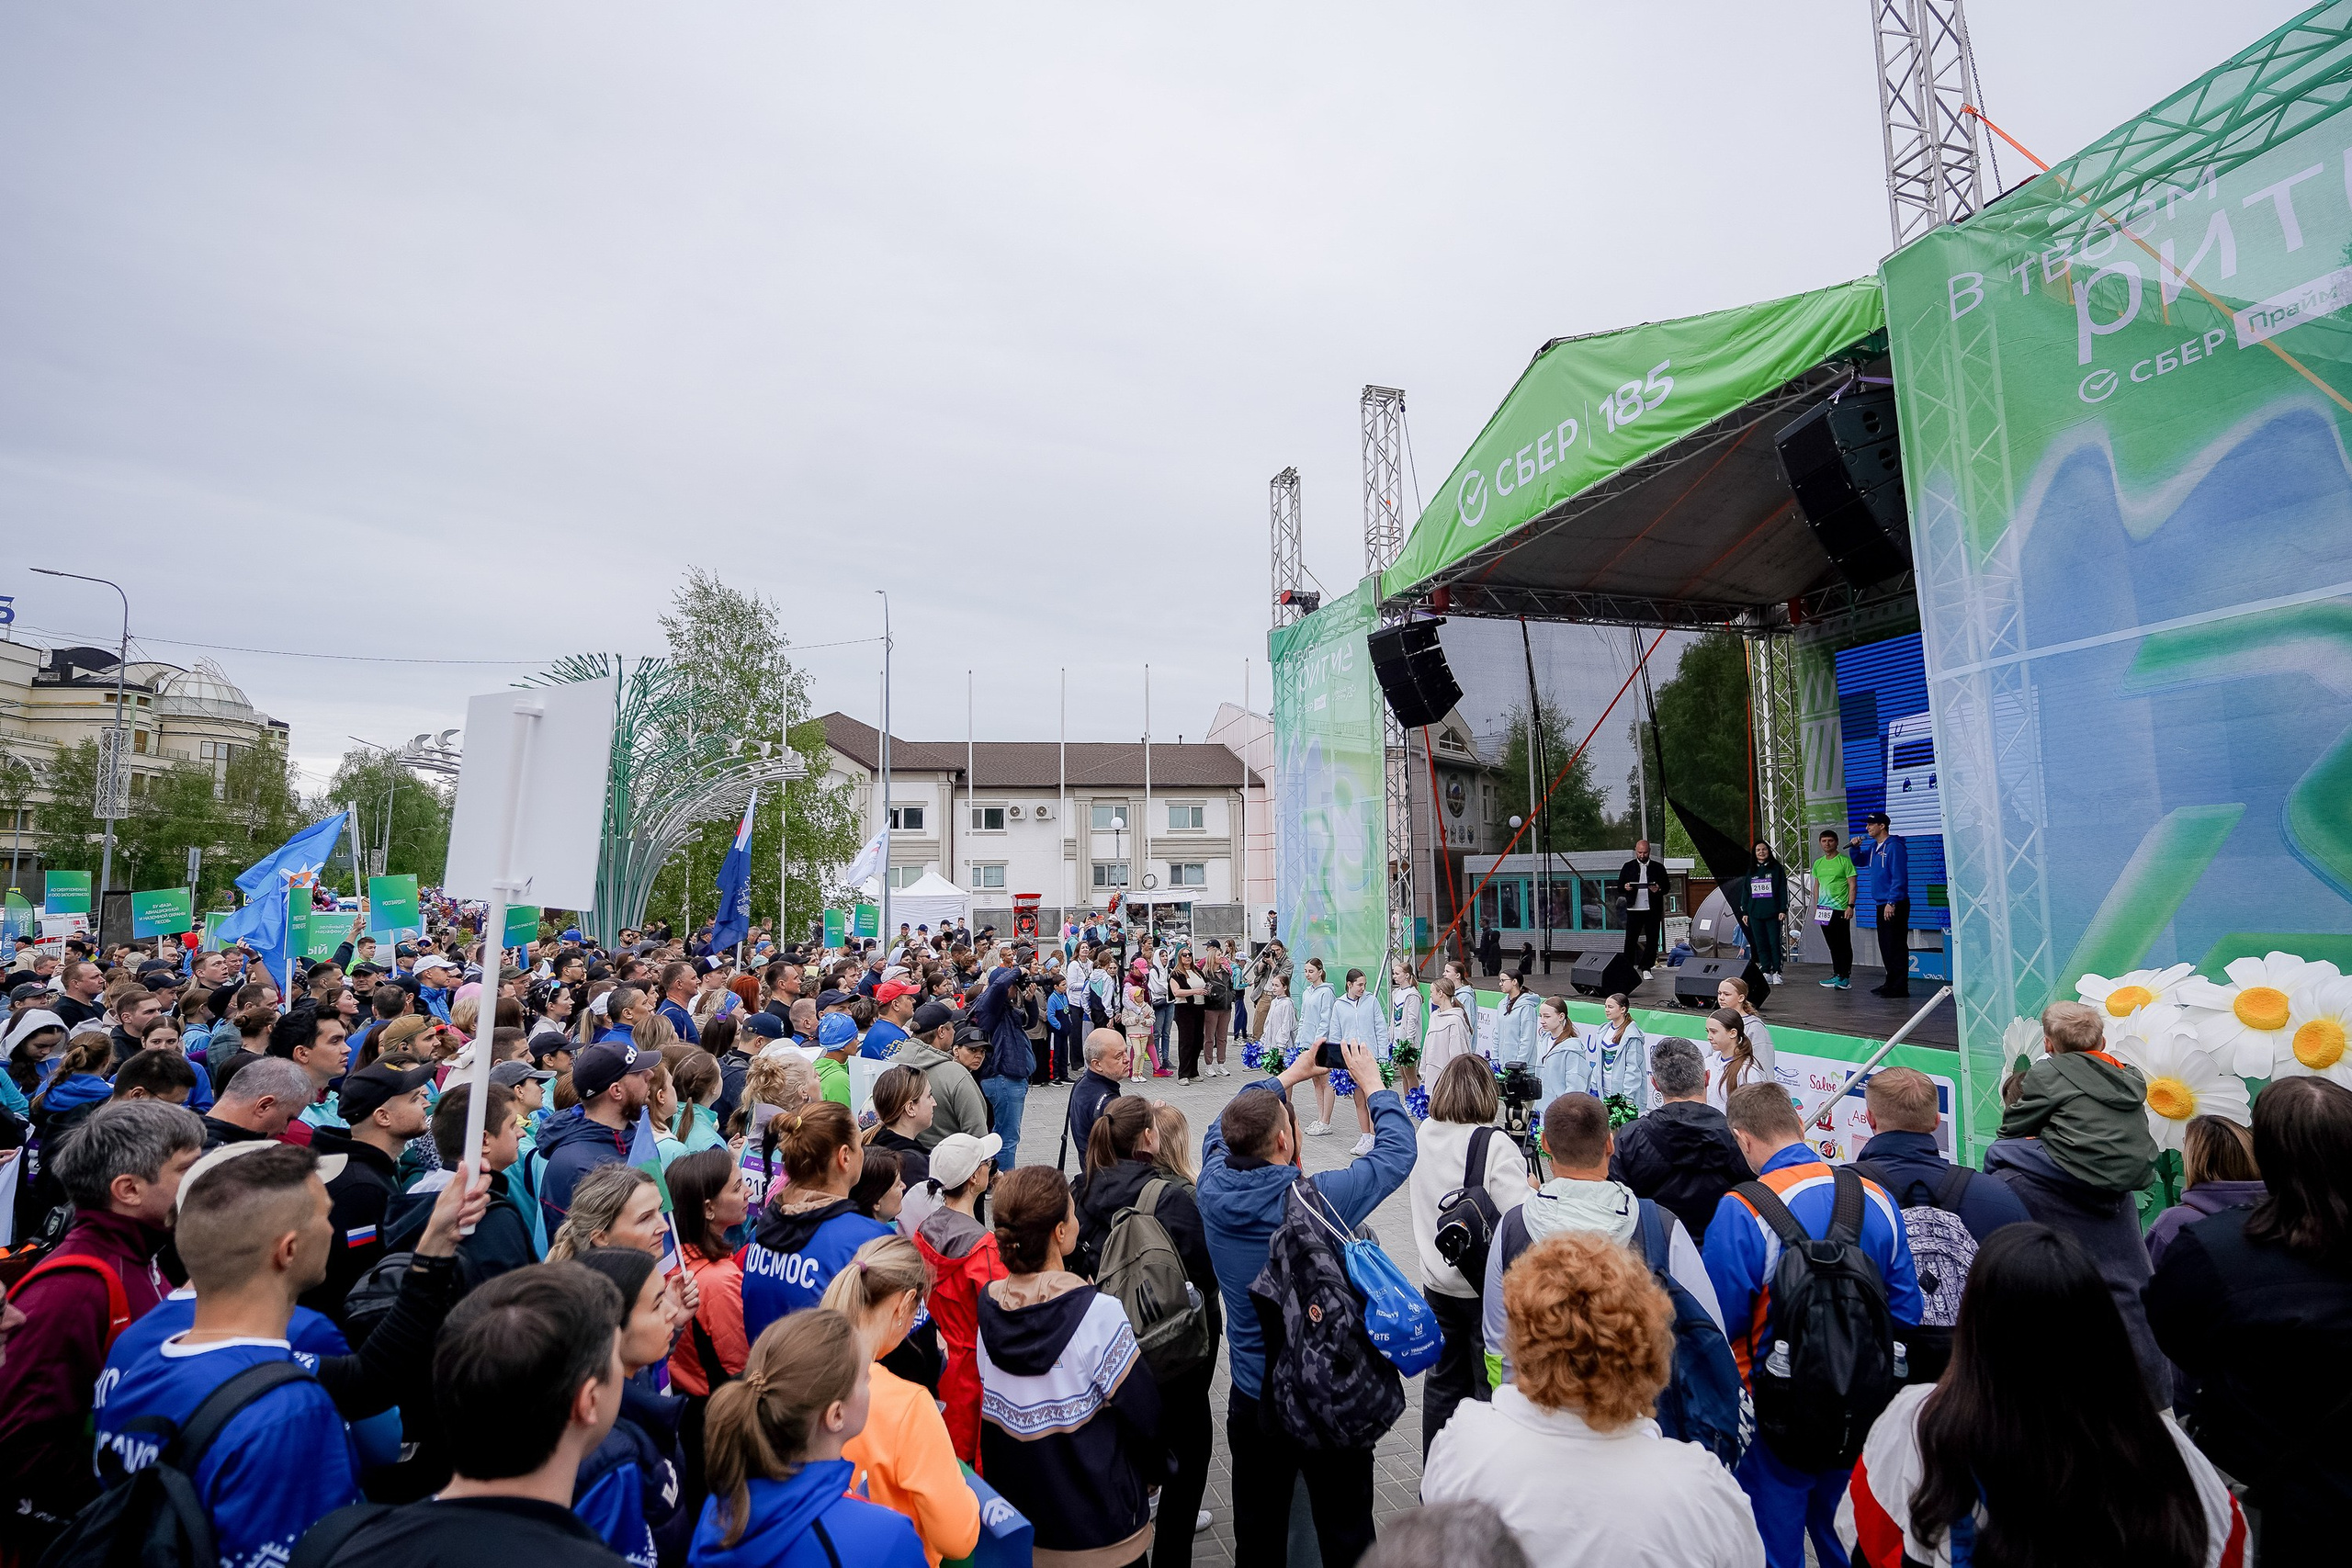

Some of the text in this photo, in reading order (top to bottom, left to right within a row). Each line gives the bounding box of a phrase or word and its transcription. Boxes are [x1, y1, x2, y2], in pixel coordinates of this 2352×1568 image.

[2072, 145, 2352, 367] рит
[1947, 270, 1984, 321] В
[2130, 282, 2341, 384] СБЕР Прайм
[1495, 358, 1675, 497] СБЕР 185
[1908, 955, 1920, 973] 2
[1809, 1074, 1838, 1093] Salve
[1374, 1333, 1390, 1341] ВТБ
